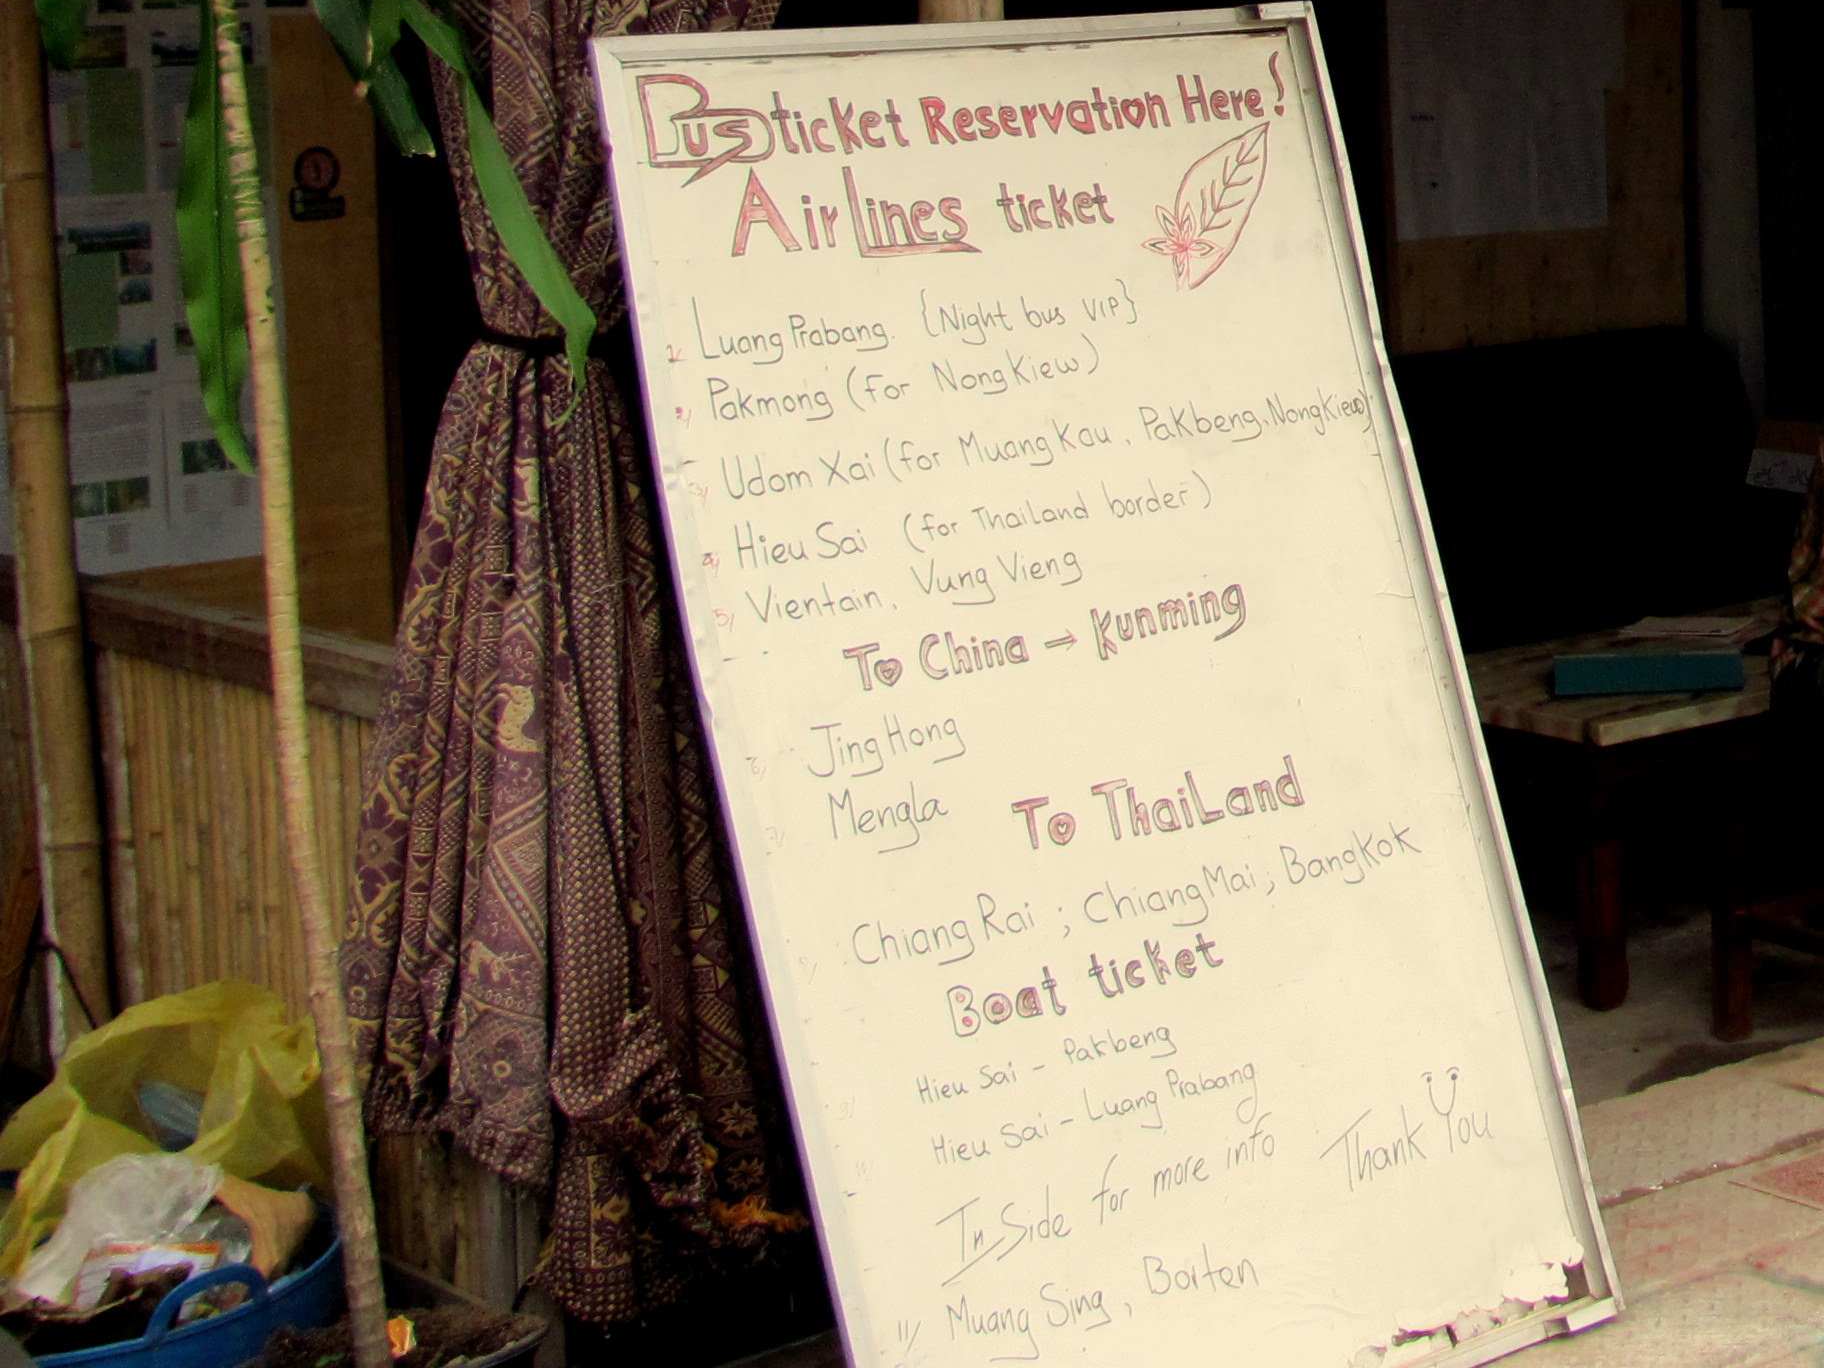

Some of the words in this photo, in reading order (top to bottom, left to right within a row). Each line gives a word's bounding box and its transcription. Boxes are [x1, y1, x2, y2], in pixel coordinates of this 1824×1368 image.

[771, 91, 910, 155] ticket
[918, 87, 1171, 146] Reservation
[997, 182, 1115, 233] ticket
[692, 296, 785, 366] Luang
[1020, 296, 1066, 328] bus
[721, 454, 813, 500] Udom
[819, 450, 876, 487] Xai
[735, 520, 810, 569] Hieu
[815, 521, 868, 560] Sai
[910, 559, 997, 605] Vung
[996, 551, 1084, 587] Vieng
[919, 631, 1030, 680] China
[828, 781, 949, 854] Mengla
[852, 920, 976, 966] Chiang
[947, 966, 1068, 1038] Boat
[1088, 933, 1224, 998] ticket
[916, 1075, 969, 1104] Hieu
[979, 1061, 1017, 1091] Sai
[932, 1137, 991, 1165] Hieu
[1000, 1113, 1050, 1149] Sai
[1083, 1087, 1164, 1130] Luang
[1166, 1062, 1258, 1124] Prabang
[1091, 1153, 1130, 1225] for
[1153, 1156, 1210, 1199] more
[1226, 1112, 1276, 1170] info
[1319, 1103, 1427, 1192] Thank
[1427, 1077, 1495, 1154] You
[947, 1294, 1040, 1362] Muang
